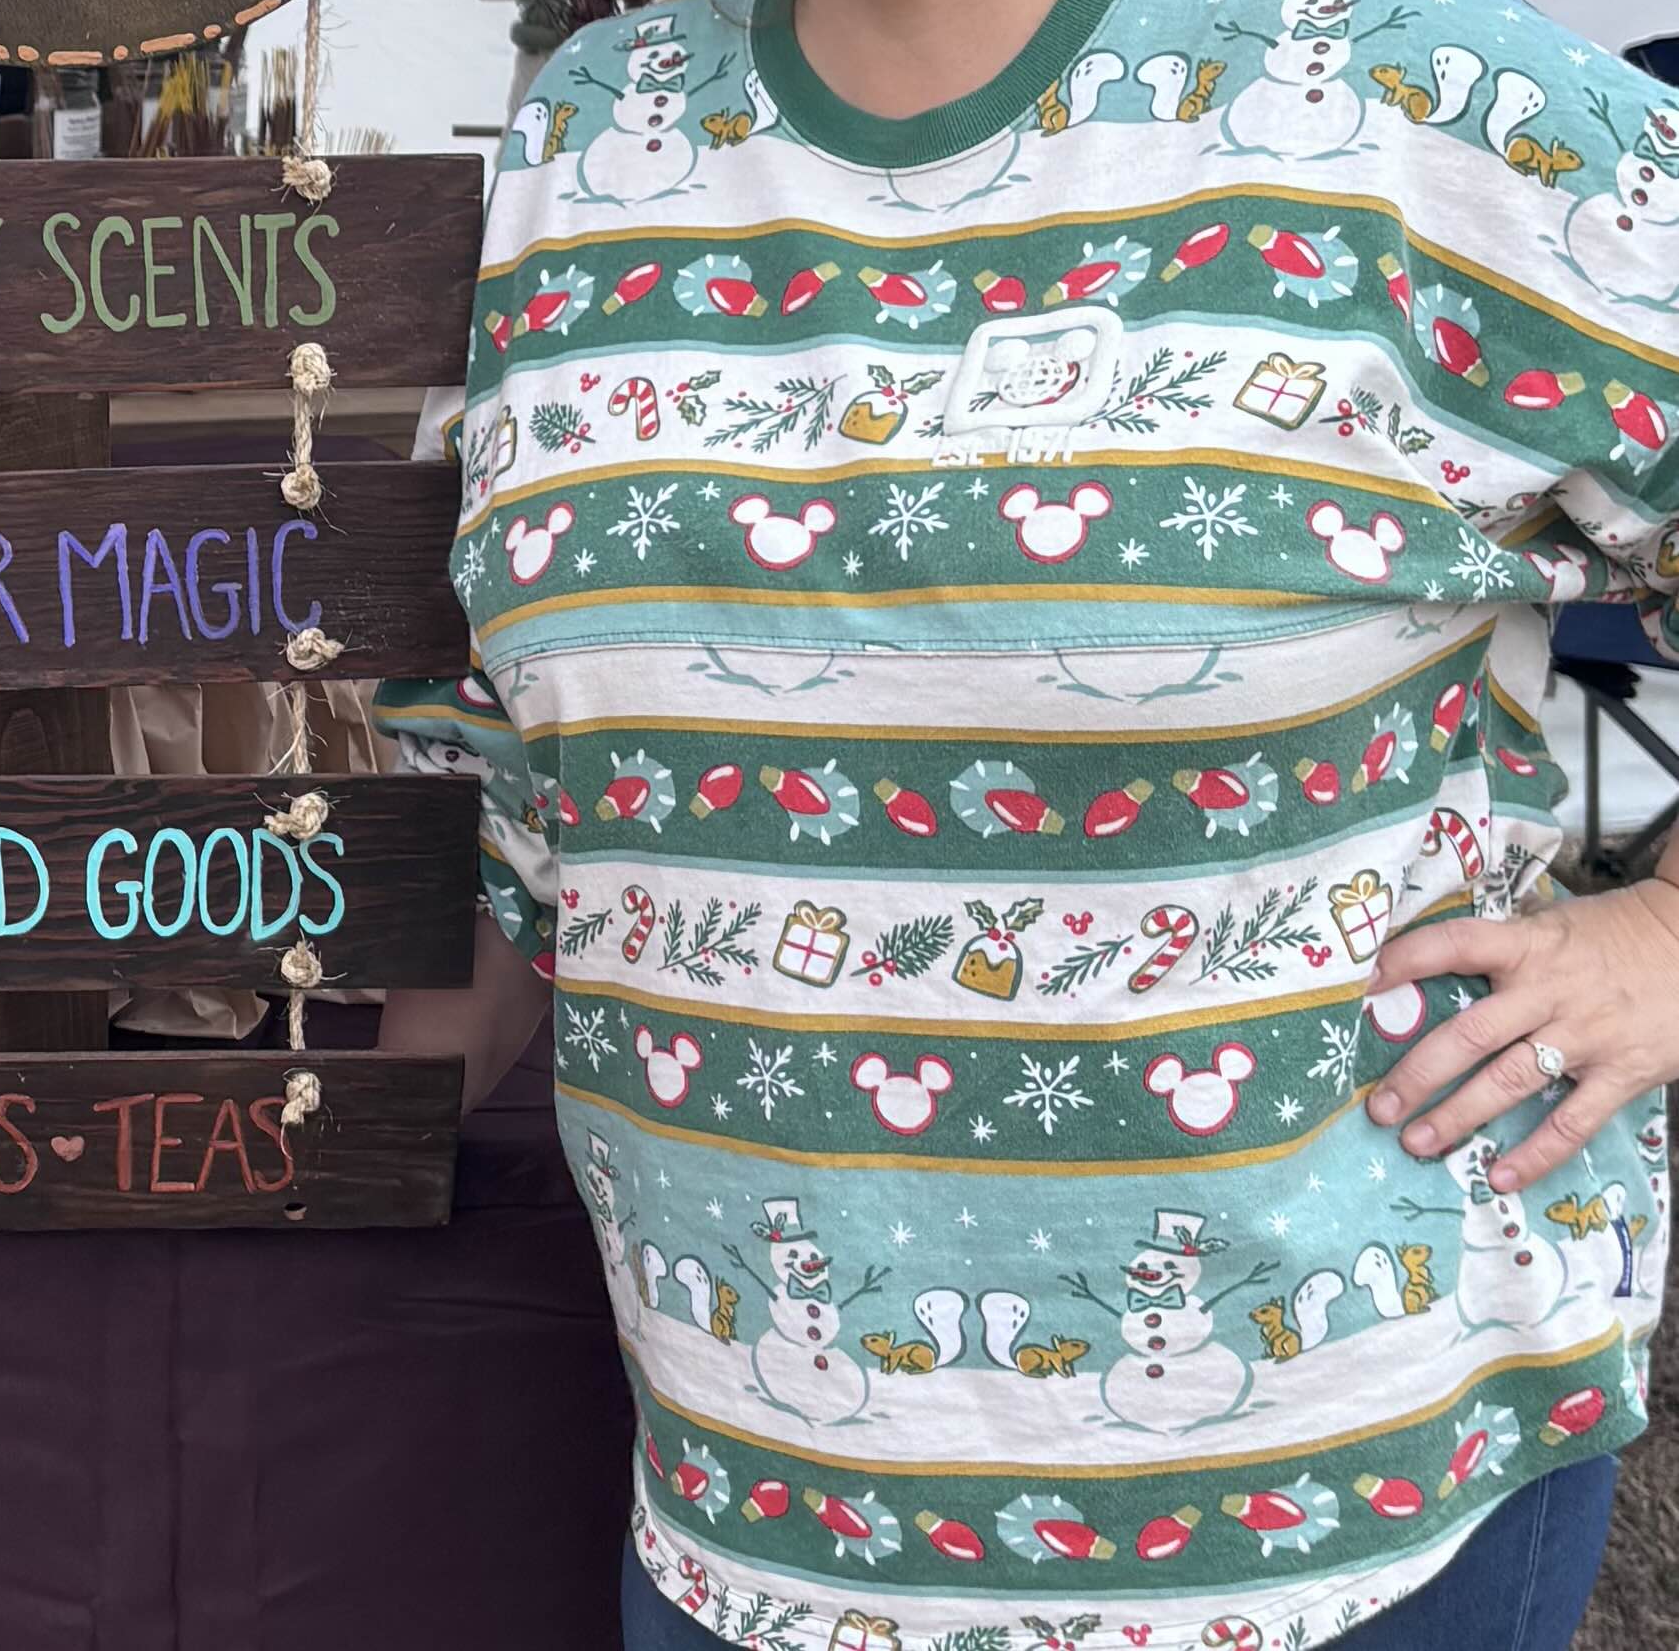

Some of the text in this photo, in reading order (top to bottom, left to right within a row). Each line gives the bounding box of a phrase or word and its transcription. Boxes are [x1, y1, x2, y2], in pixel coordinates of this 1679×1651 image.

[39, 212, 341, 335] SCENTS
[57, 520, 323, 648] MAGIC
[85, 826, 347, 942] GOODS
[92, 1092, 296, 1195] TEAS
